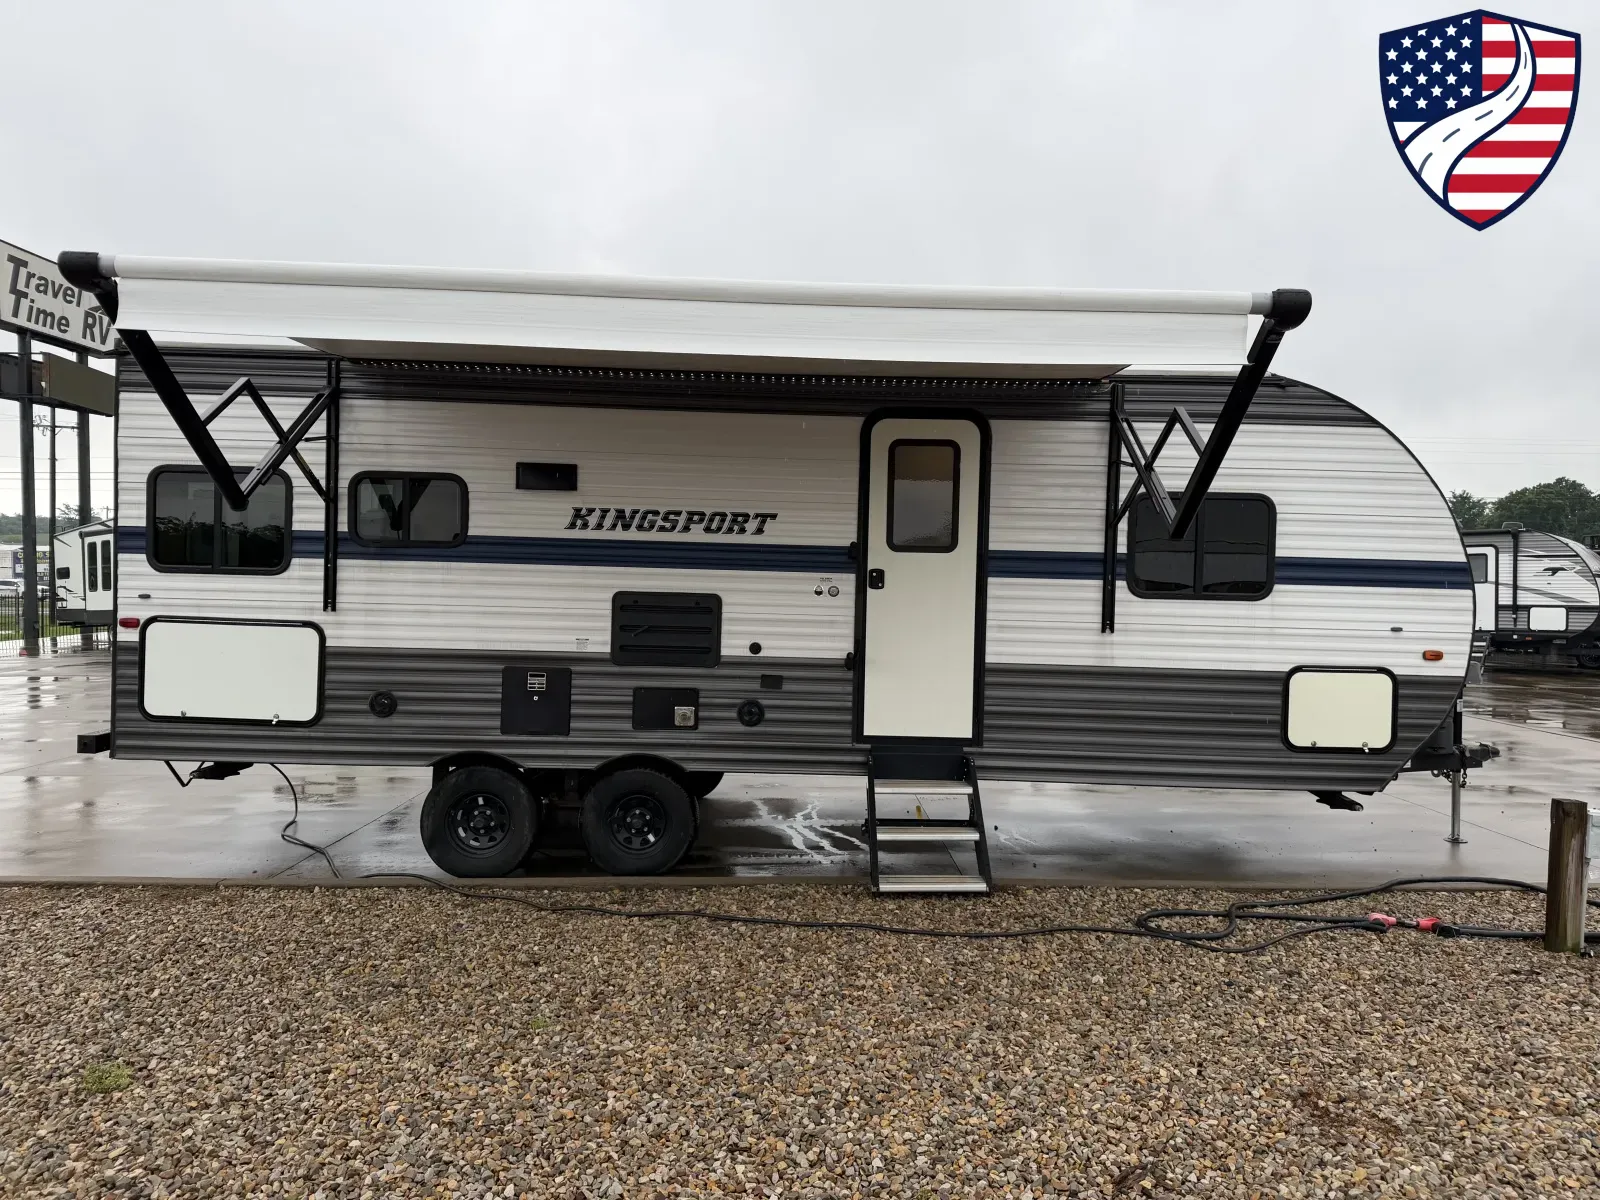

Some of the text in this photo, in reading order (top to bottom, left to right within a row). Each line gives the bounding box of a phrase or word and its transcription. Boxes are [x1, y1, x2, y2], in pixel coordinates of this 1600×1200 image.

[7, 253, 83, 308] Travel
[11, 288, 112, 346] Time RV
[564, 506, 779, 536] KINGSPORT
